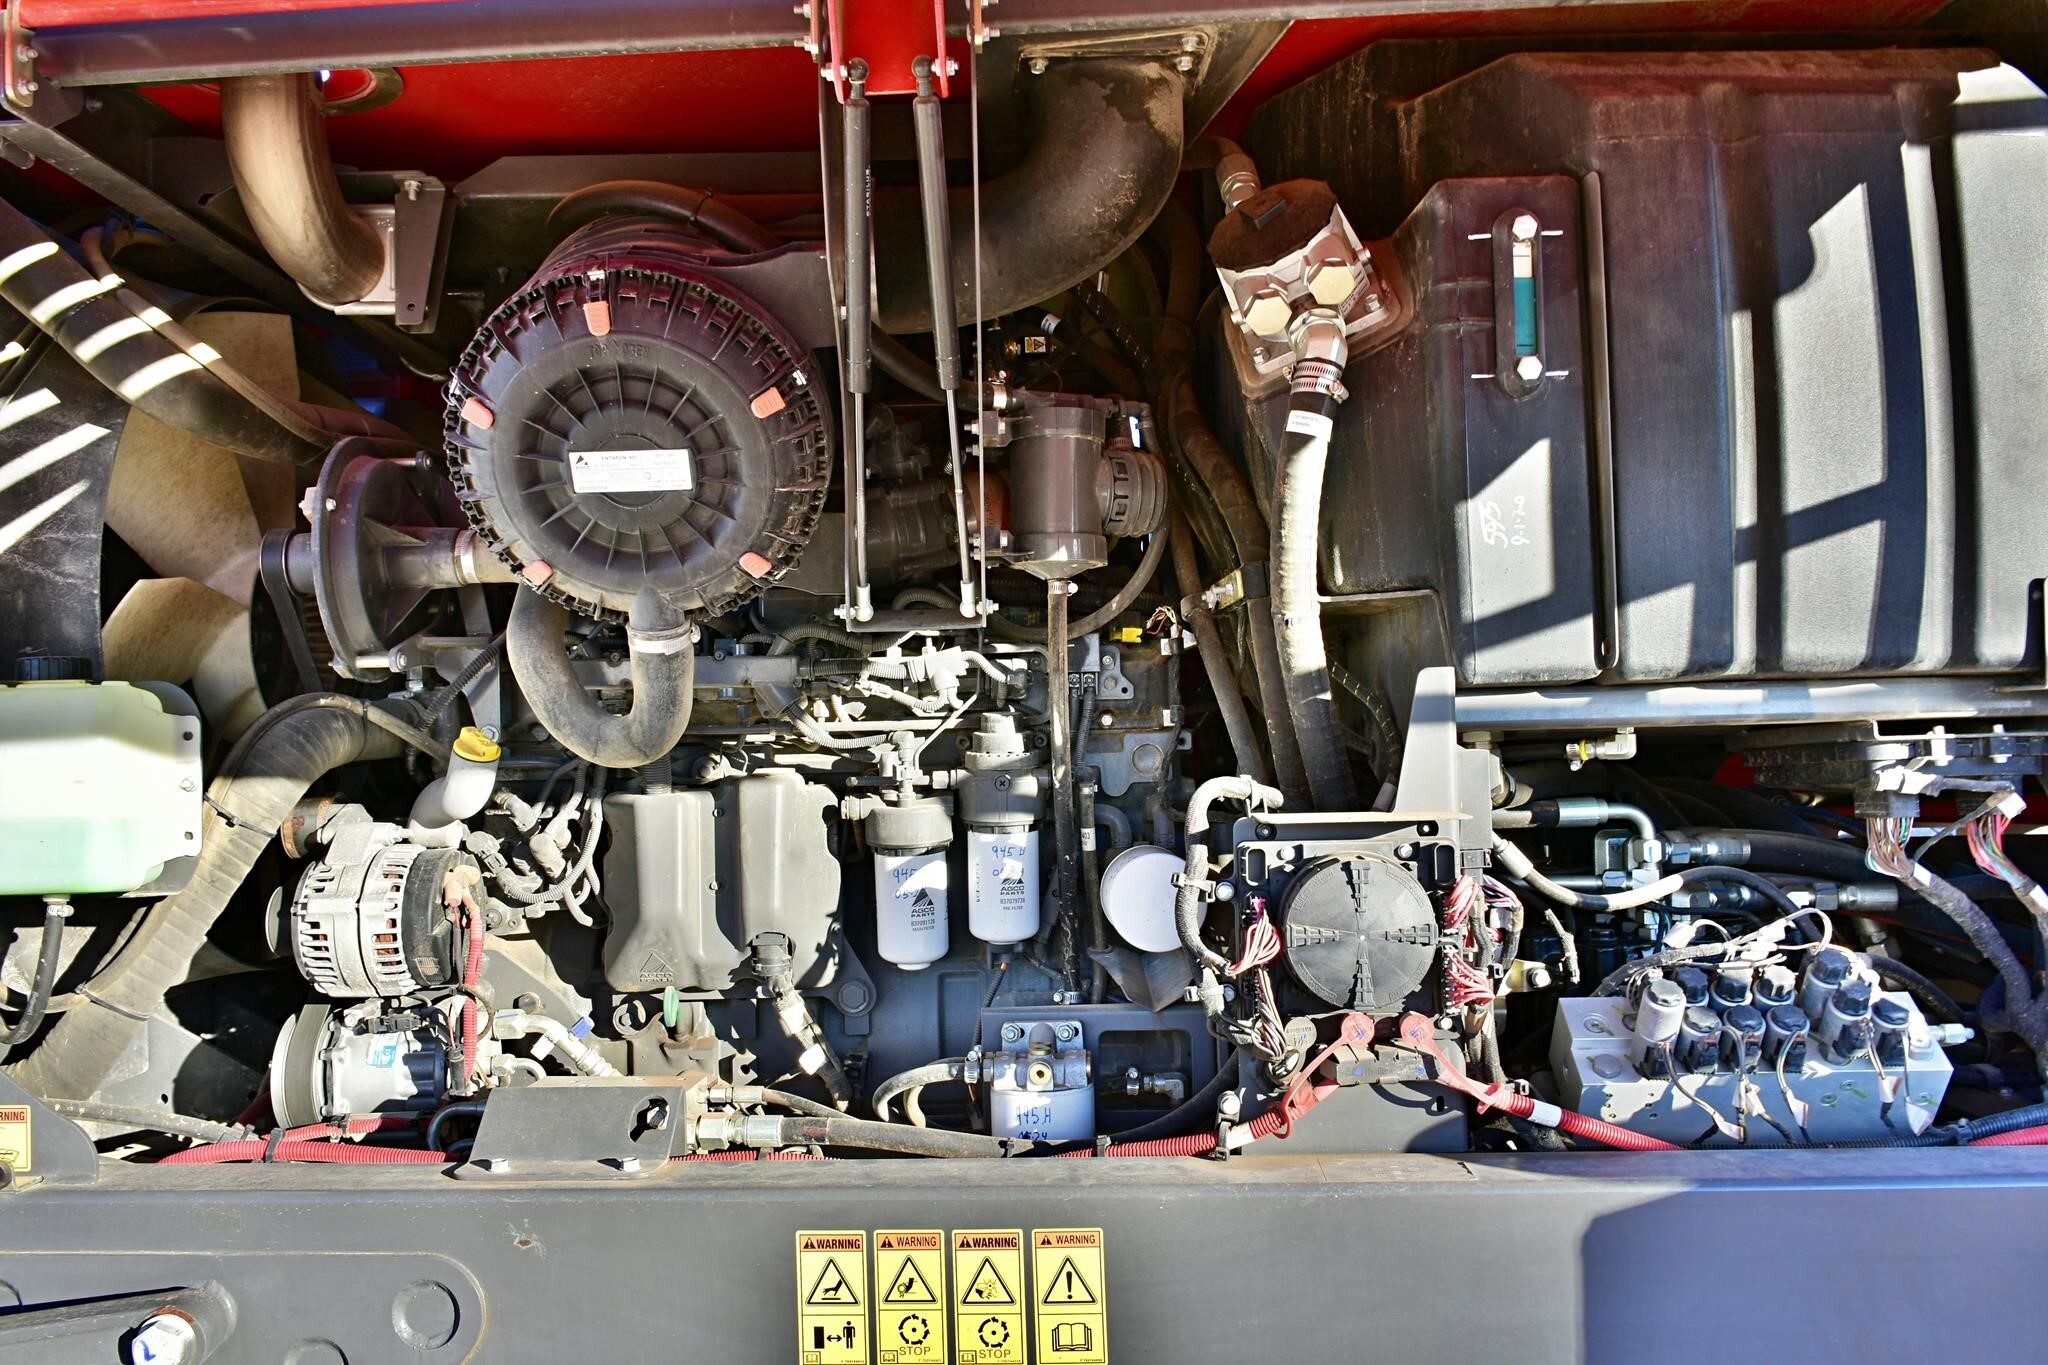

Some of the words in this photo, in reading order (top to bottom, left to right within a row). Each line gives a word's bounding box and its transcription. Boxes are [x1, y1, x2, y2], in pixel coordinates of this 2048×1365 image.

[911, 906, 935, 914] AGCO
[816, 1238, 861, 1250] WARNING
[896, 1236, 937, 1247] WARNING
[972, 1237, 1018, 1249] WARNING
[1056, 1234, 1096, 1245] WARNING
[898, 1346, 931, 1356] STOP
[978, 1349, 1011, 1359] STOP
